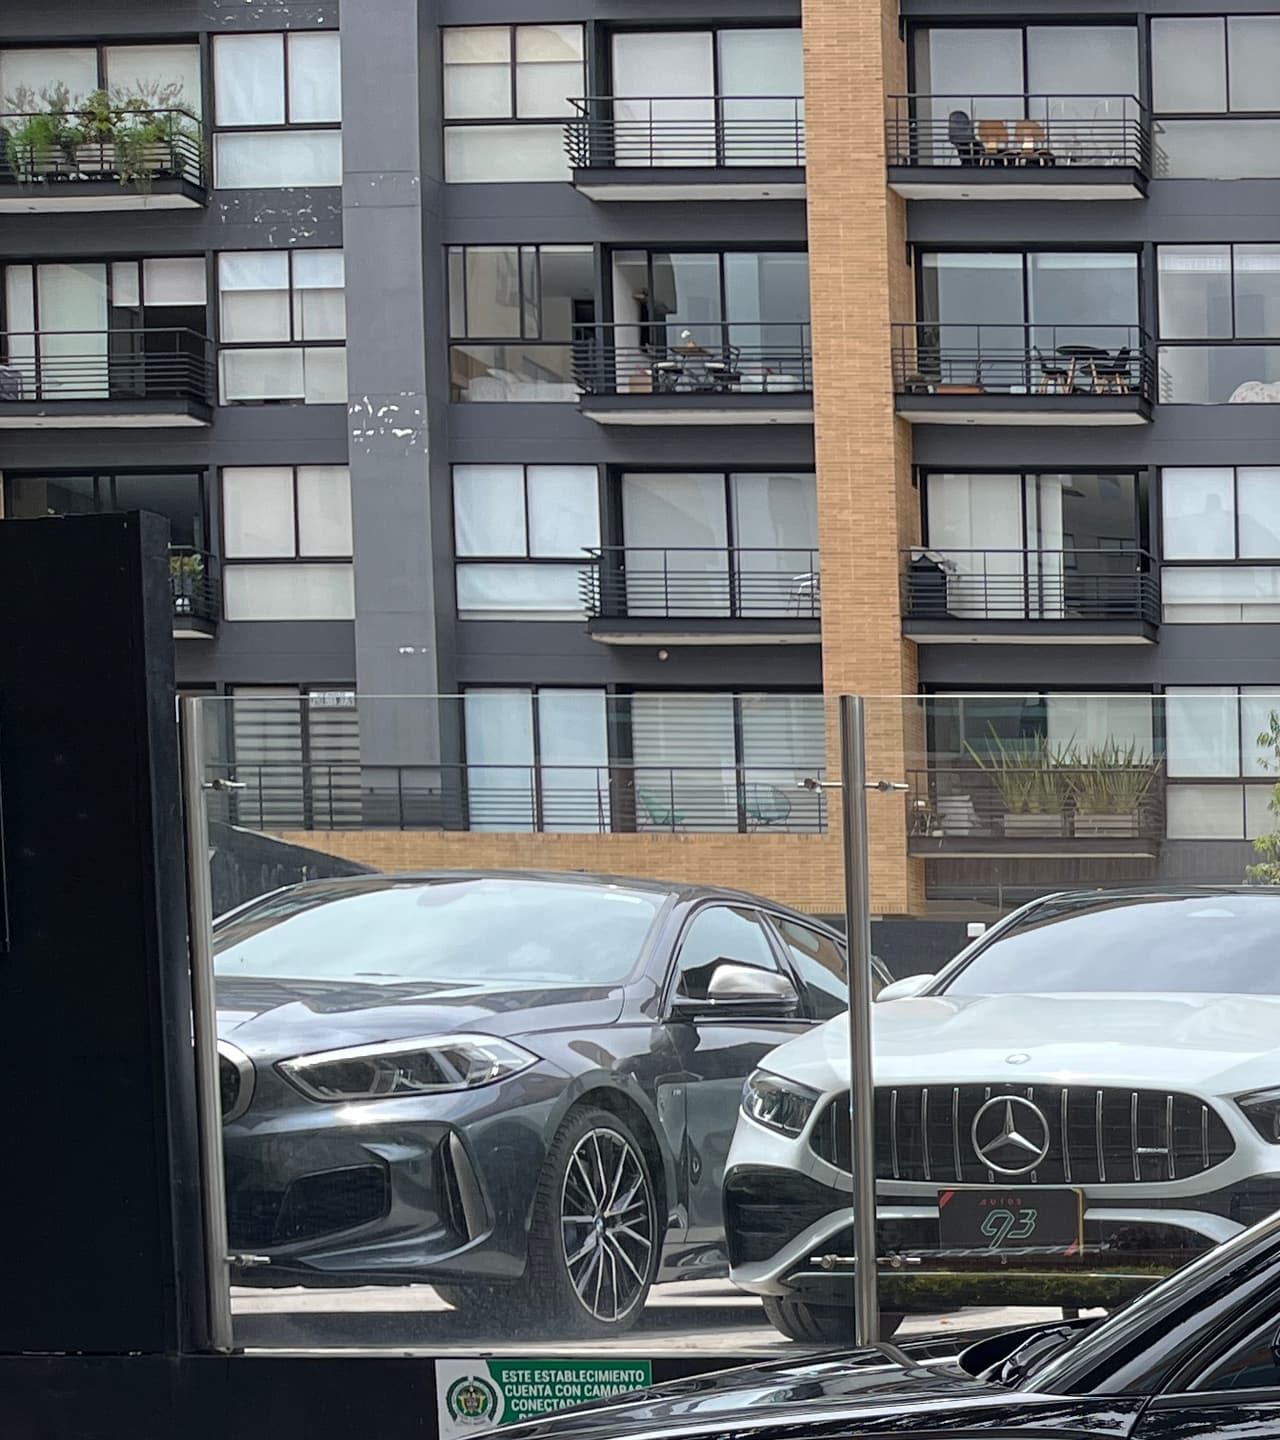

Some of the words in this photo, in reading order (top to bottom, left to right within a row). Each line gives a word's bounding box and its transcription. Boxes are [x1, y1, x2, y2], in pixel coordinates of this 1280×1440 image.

[980, 1209, 1038, 1249] 93
[502, 1369, 532, 1383] ESTE
[534, 1369, 645, 1383] ESTABLECIMIENTO
[504, 1384, 553, 1397] CUENTA
[555, 1384, 582, 1397] CON
[511, 1398, 588, 1411] CONECTAD
